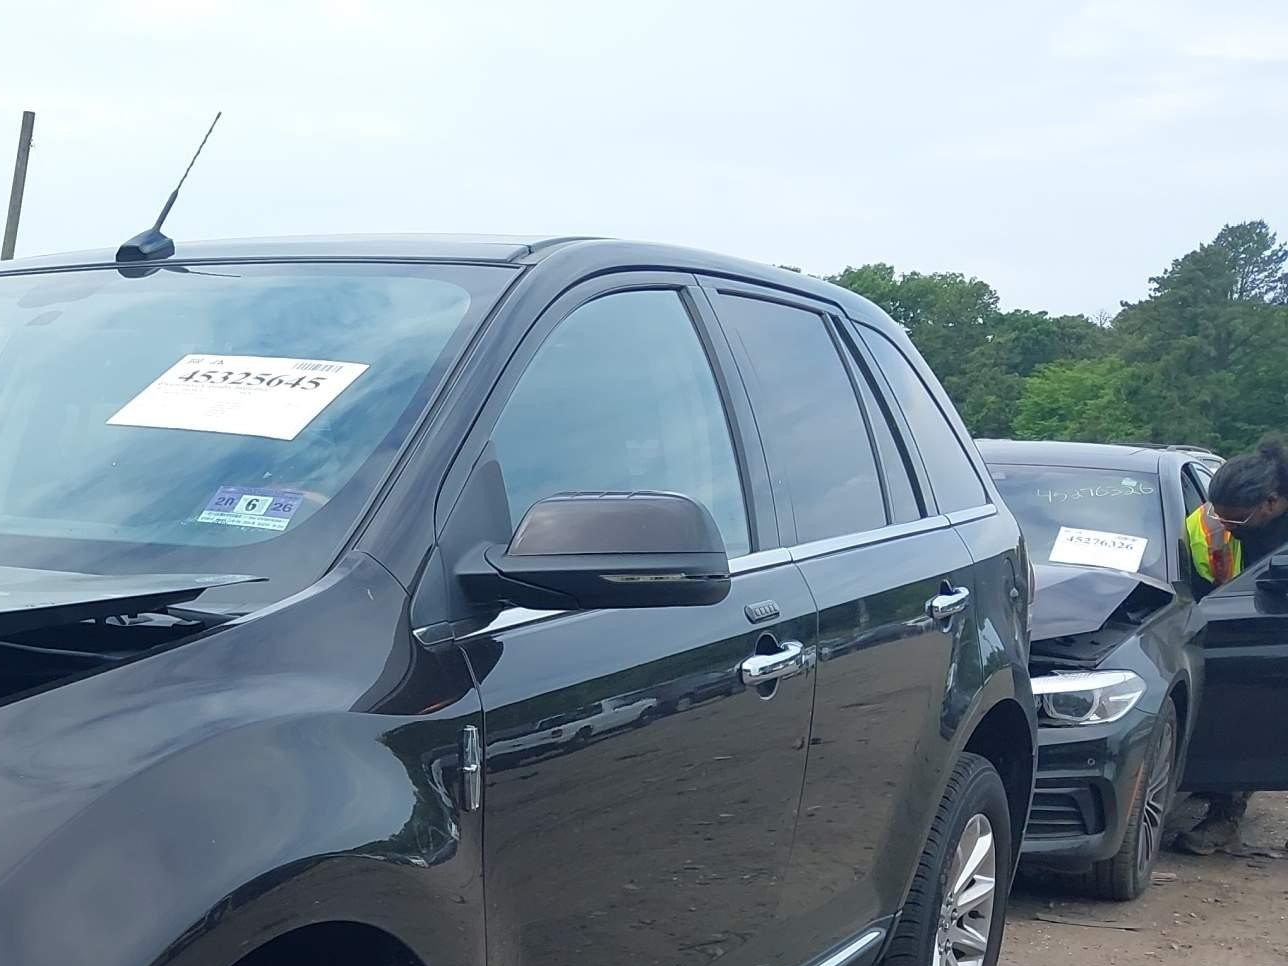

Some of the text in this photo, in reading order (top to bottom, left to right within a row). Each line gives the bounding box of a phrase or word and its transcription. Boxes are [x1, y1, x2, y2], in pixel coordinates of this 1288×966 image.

[177, 369, 329, 391] 45325645
[1035, 483, 1154, 504] 45276326
[245, 498, 260, 512] 6
[271, 502, 294, 513] 26
